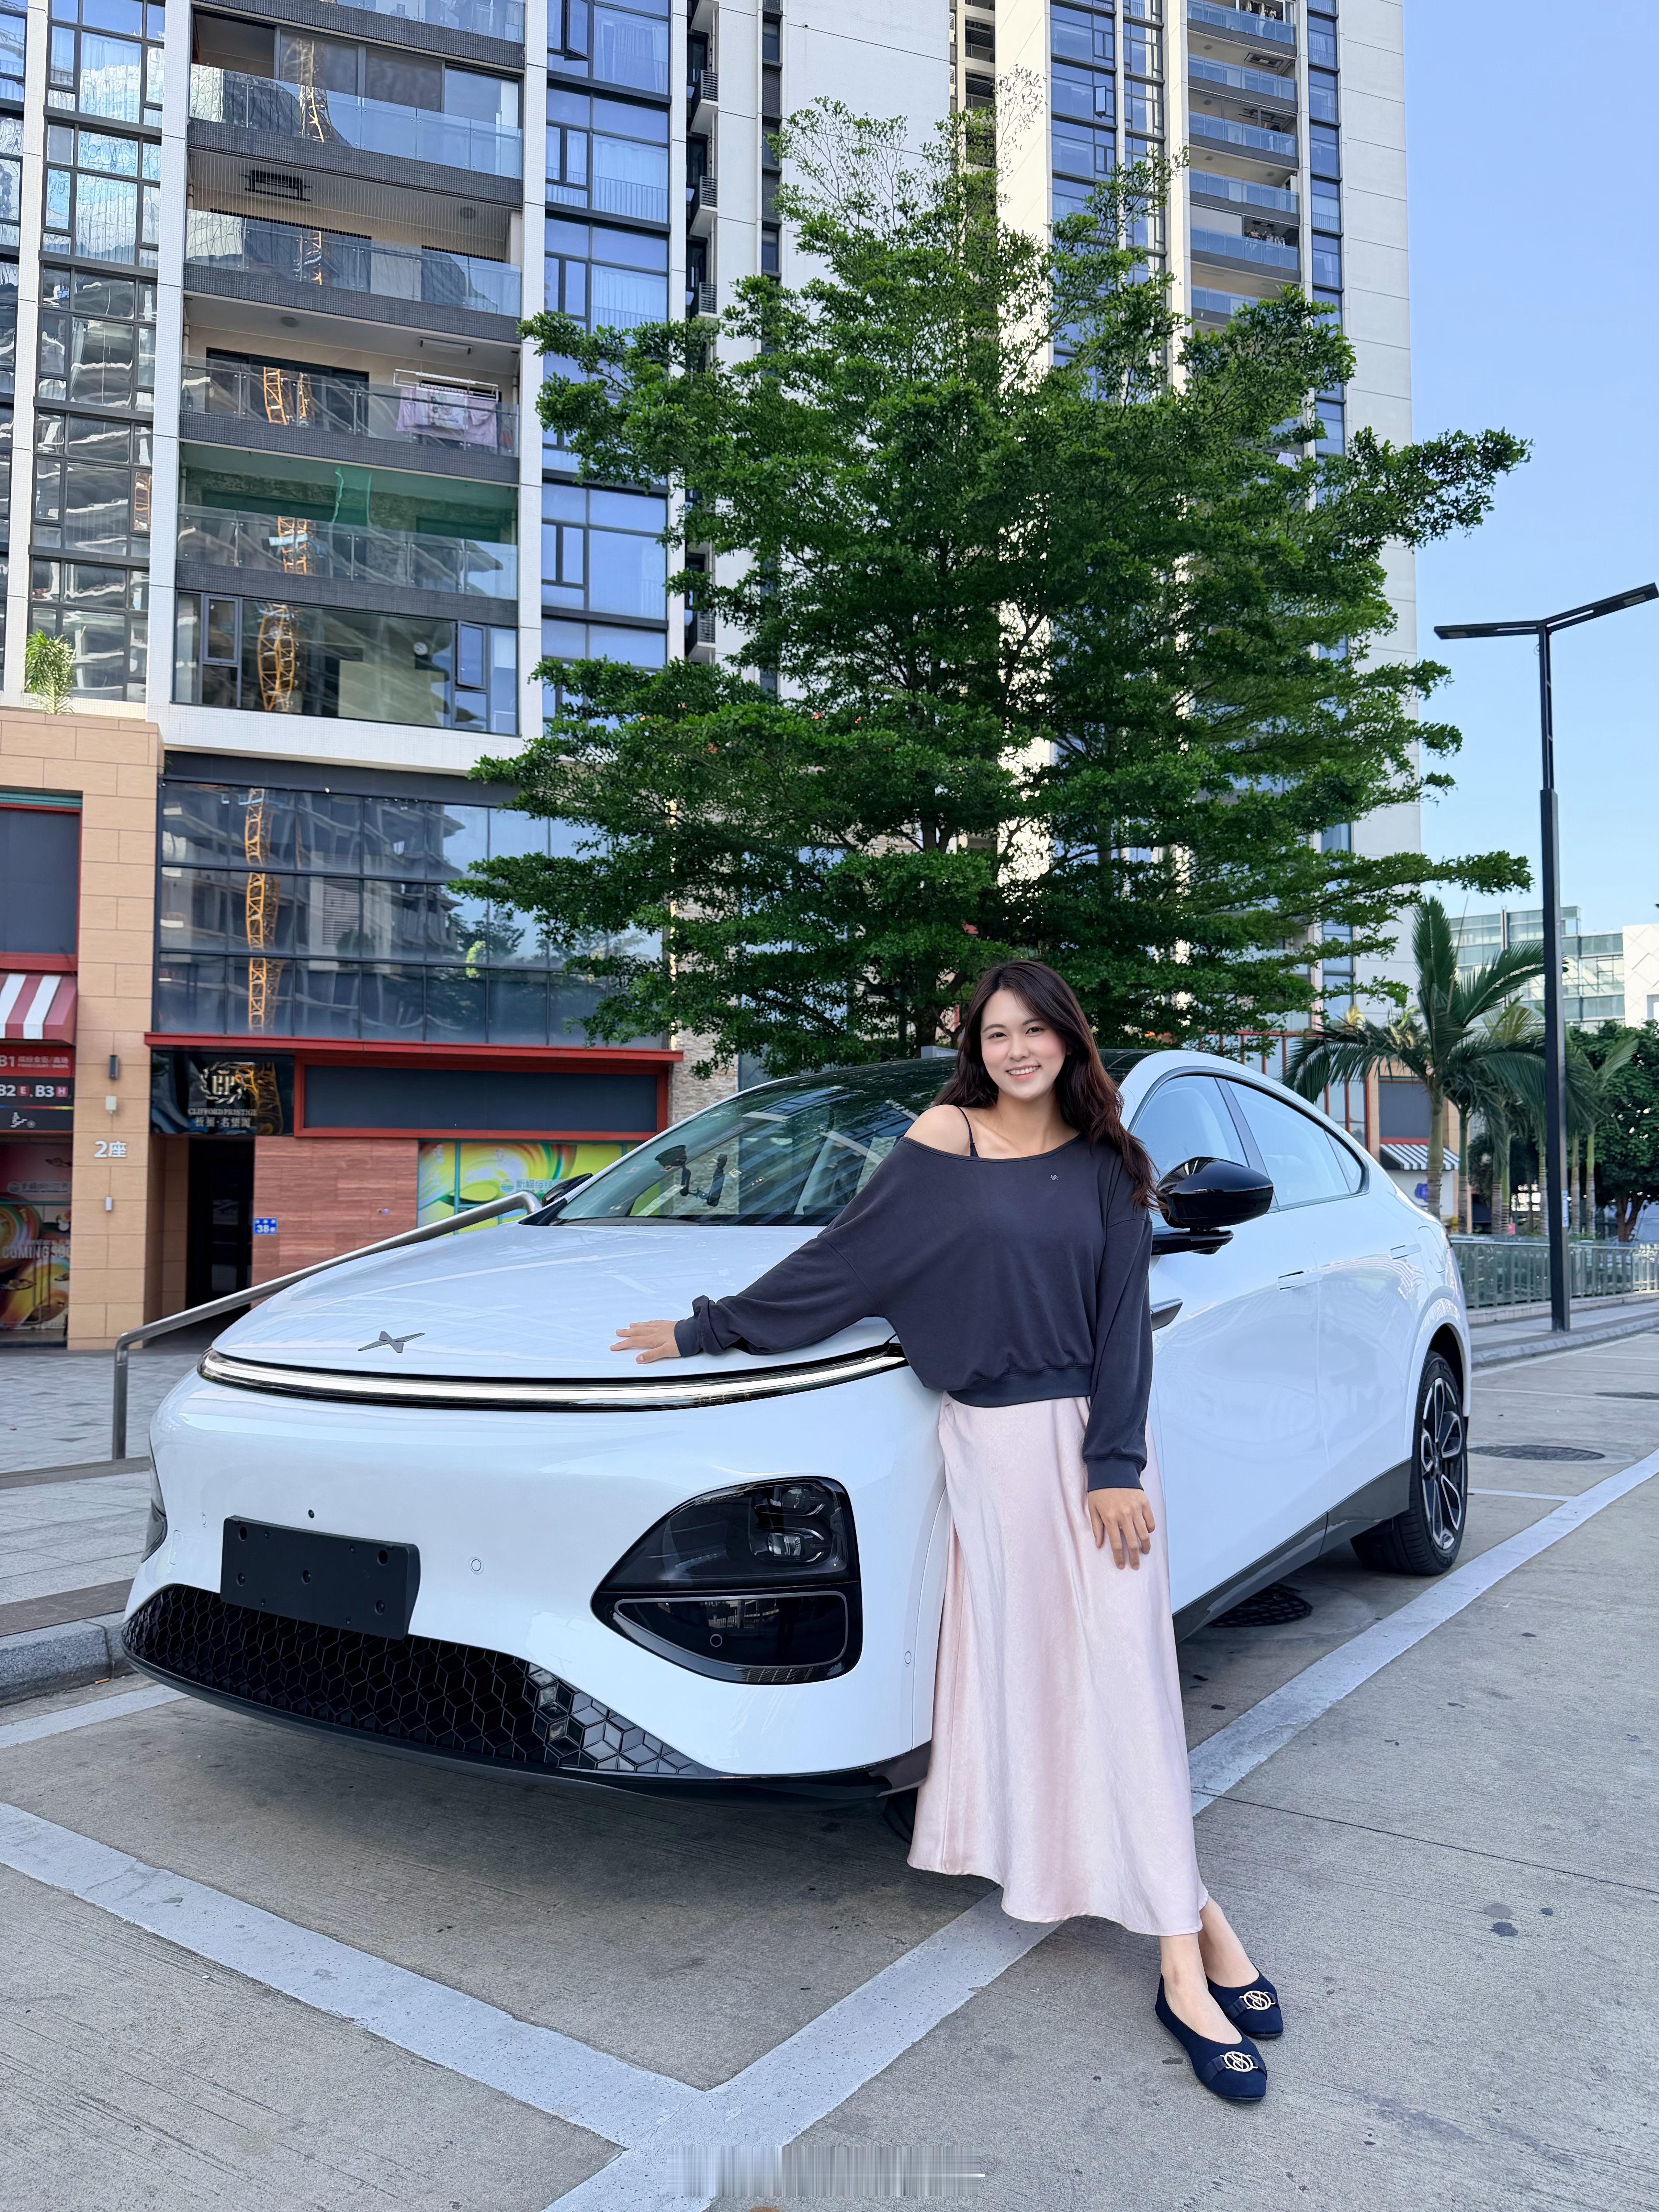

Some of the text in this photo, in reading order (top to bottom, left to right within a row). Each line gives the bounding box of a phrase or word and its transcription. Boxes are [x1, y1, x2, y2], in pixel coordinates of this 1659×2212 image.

[35, 1085, 55, 1097] B3
[94, 1140, 127, 1158] 2座
[2, 1245, 49, 1258] COMING
